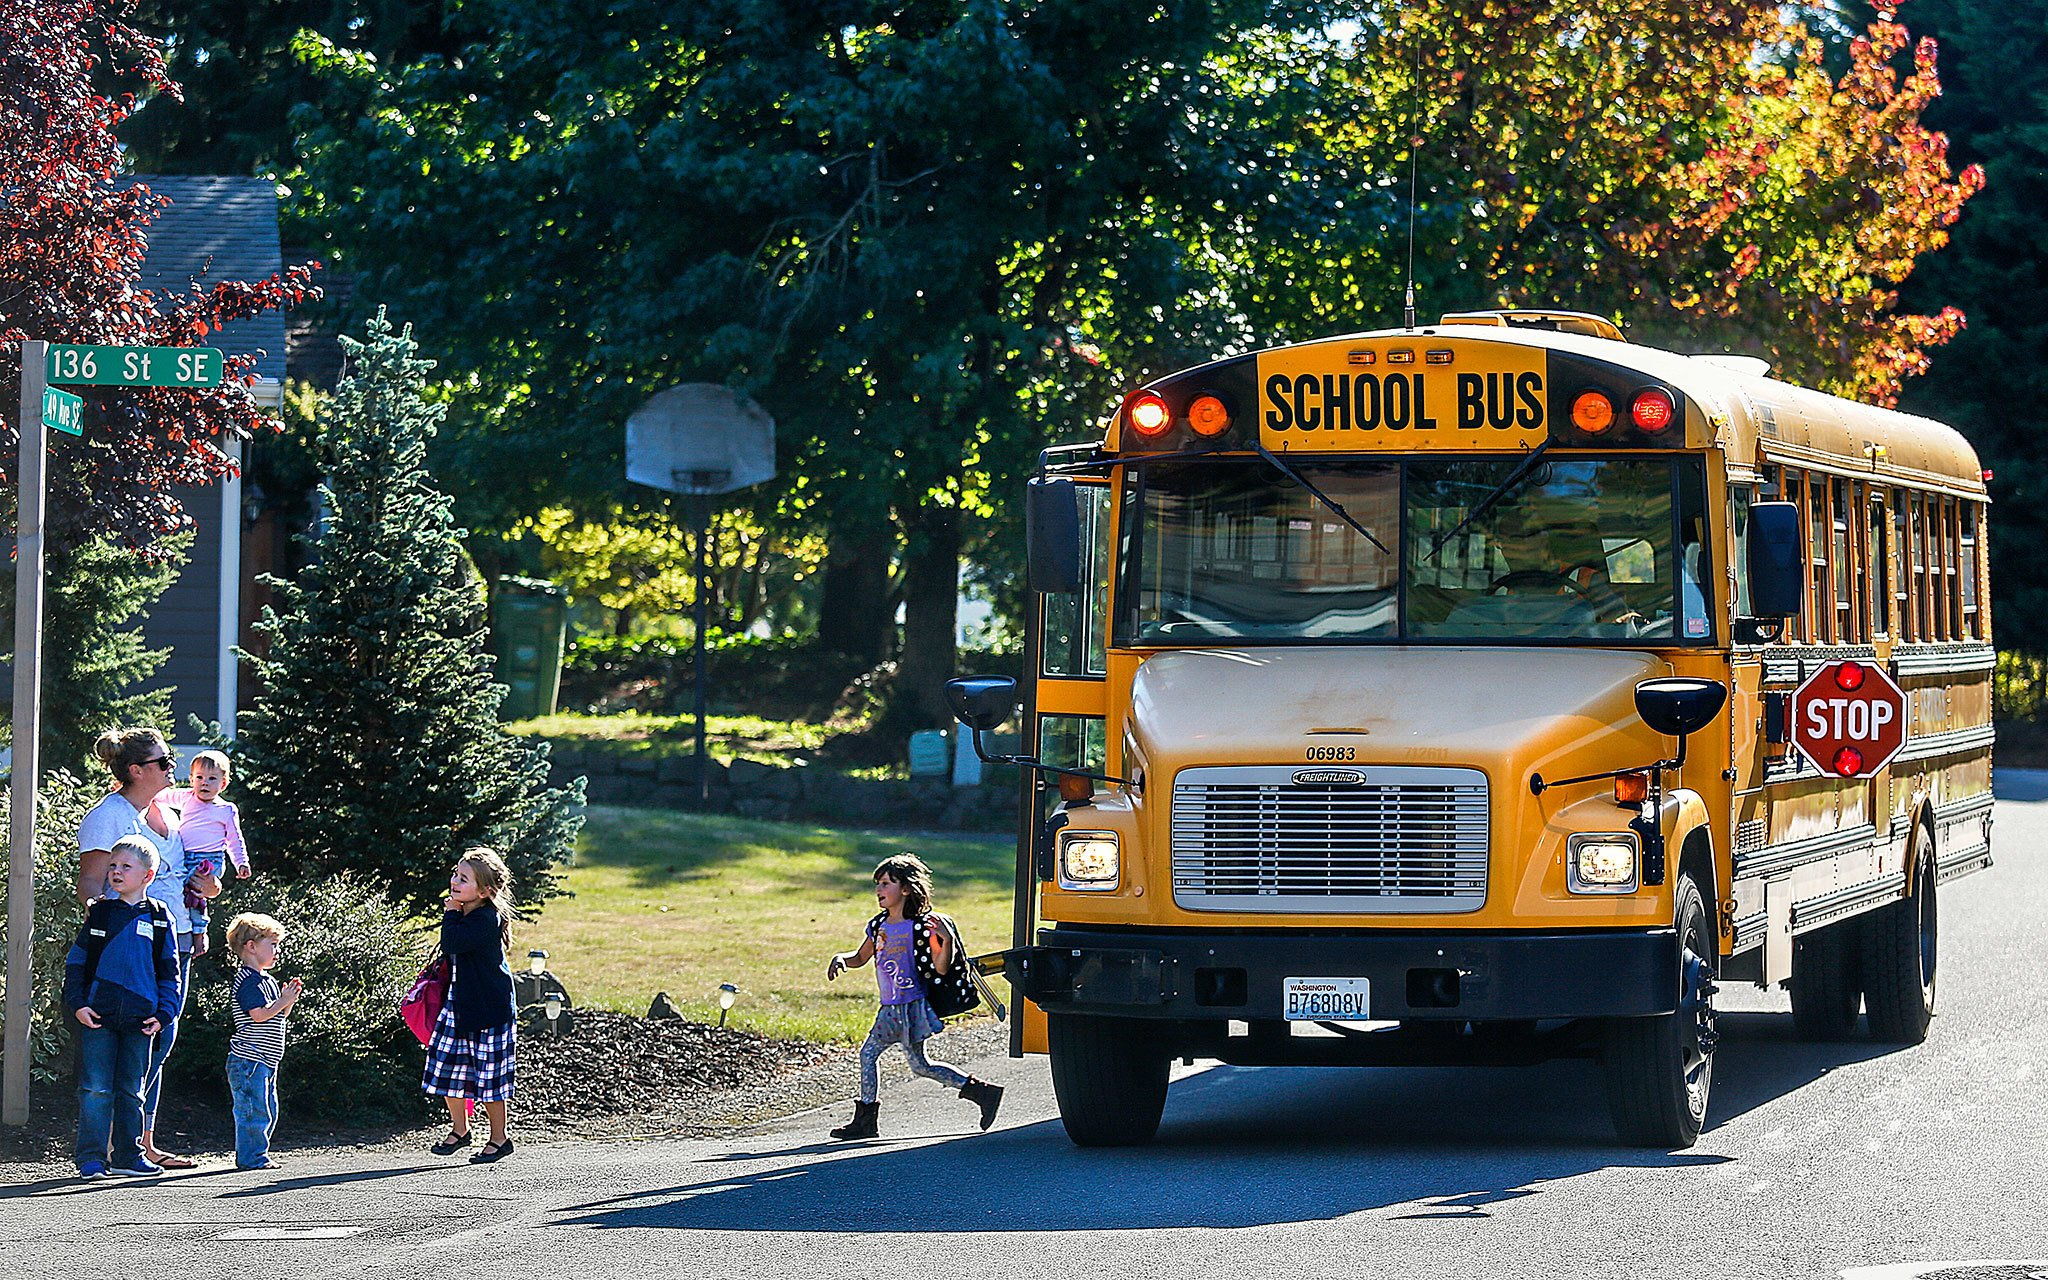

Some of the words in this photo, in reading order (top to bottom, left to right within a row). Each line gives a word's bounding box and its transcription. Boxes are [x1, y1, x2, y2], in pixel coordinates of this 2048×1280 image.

[53, 350, 97, 379] 136
[123, 353, 151, 381] St
[175, 354, 209, 382] SE
[47, 393, 57, 421] 49
[59, 397, 70, 427] Ave
[1264, 373, 1437, 431] SCHOOL
[1457, 371, 1544, 430] BUS
[1807, 698, 1894, 741] STOP
[1306, 746, 1356, 761] 06983
[1300, 773, 1358, 782] FREIGHTLINER
[1289, 993, 1364, 1014] B76808V
